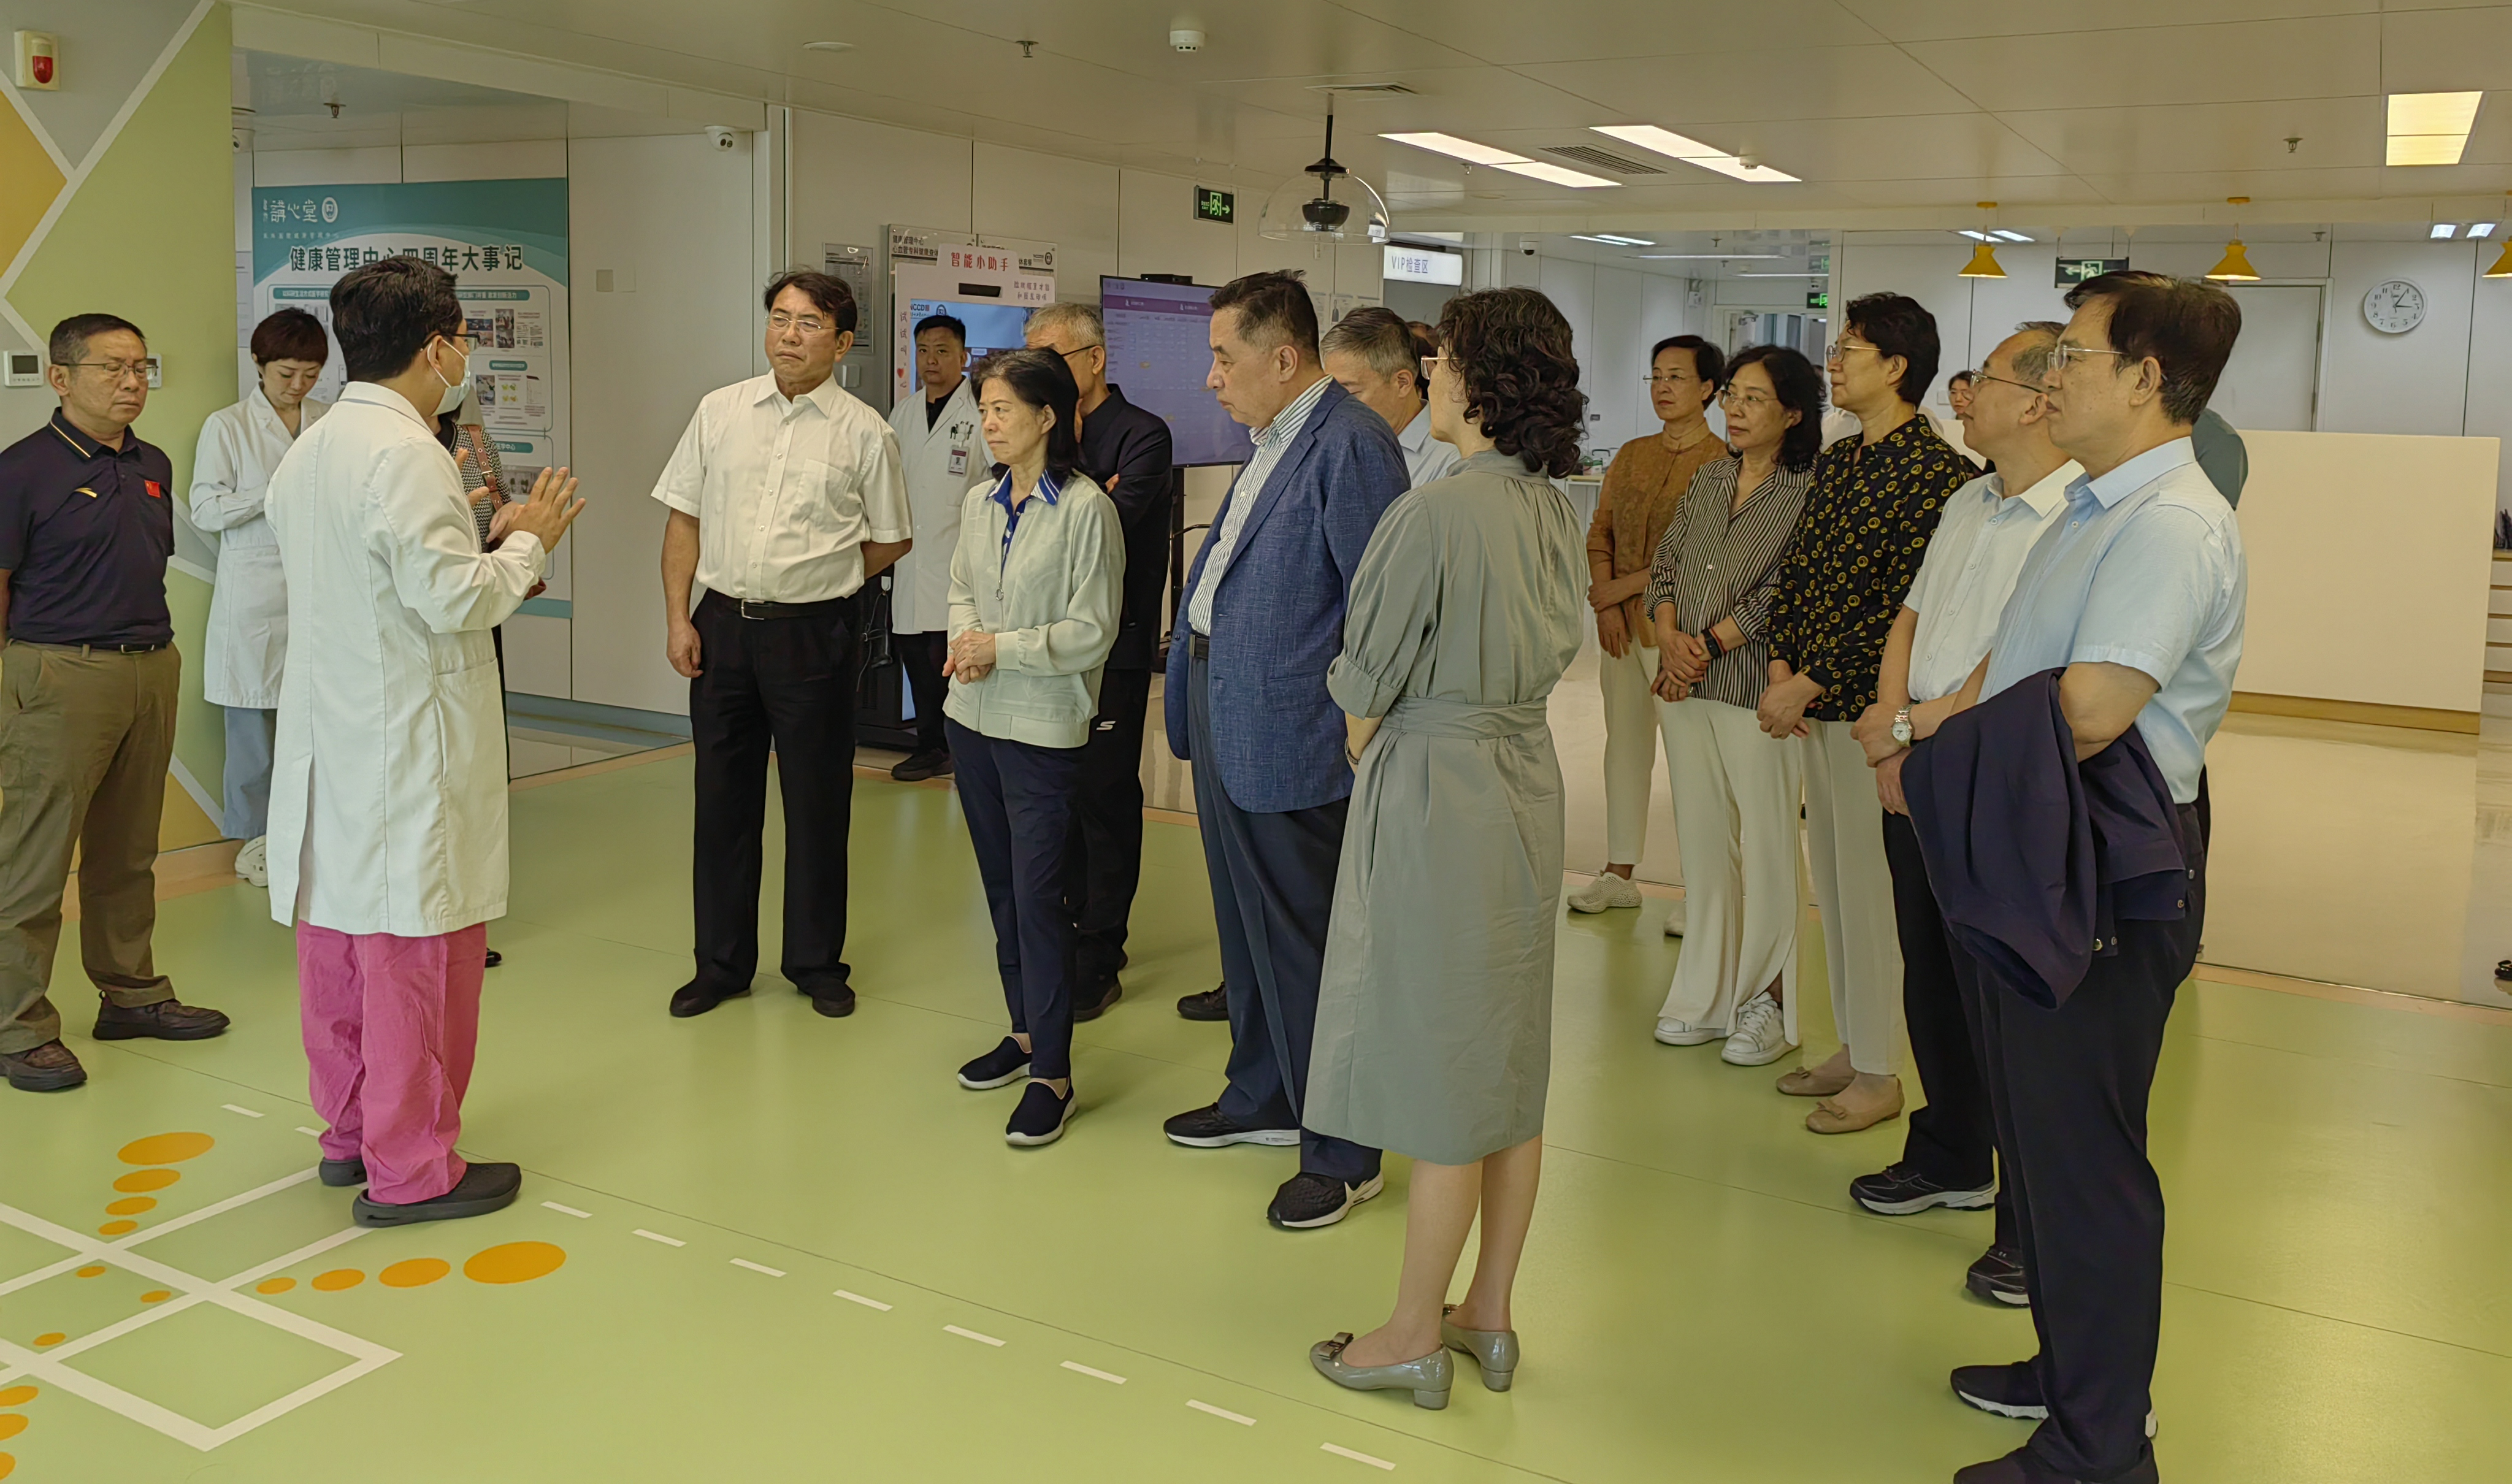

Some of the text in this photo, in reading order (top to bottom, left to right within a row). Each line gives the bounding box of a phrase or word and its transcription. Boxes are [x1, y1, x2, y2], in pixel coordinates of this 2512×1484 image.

[951, 251, 1009, 272] 智能小助手
[1392, 255, 1428, 273] VIP检查区
